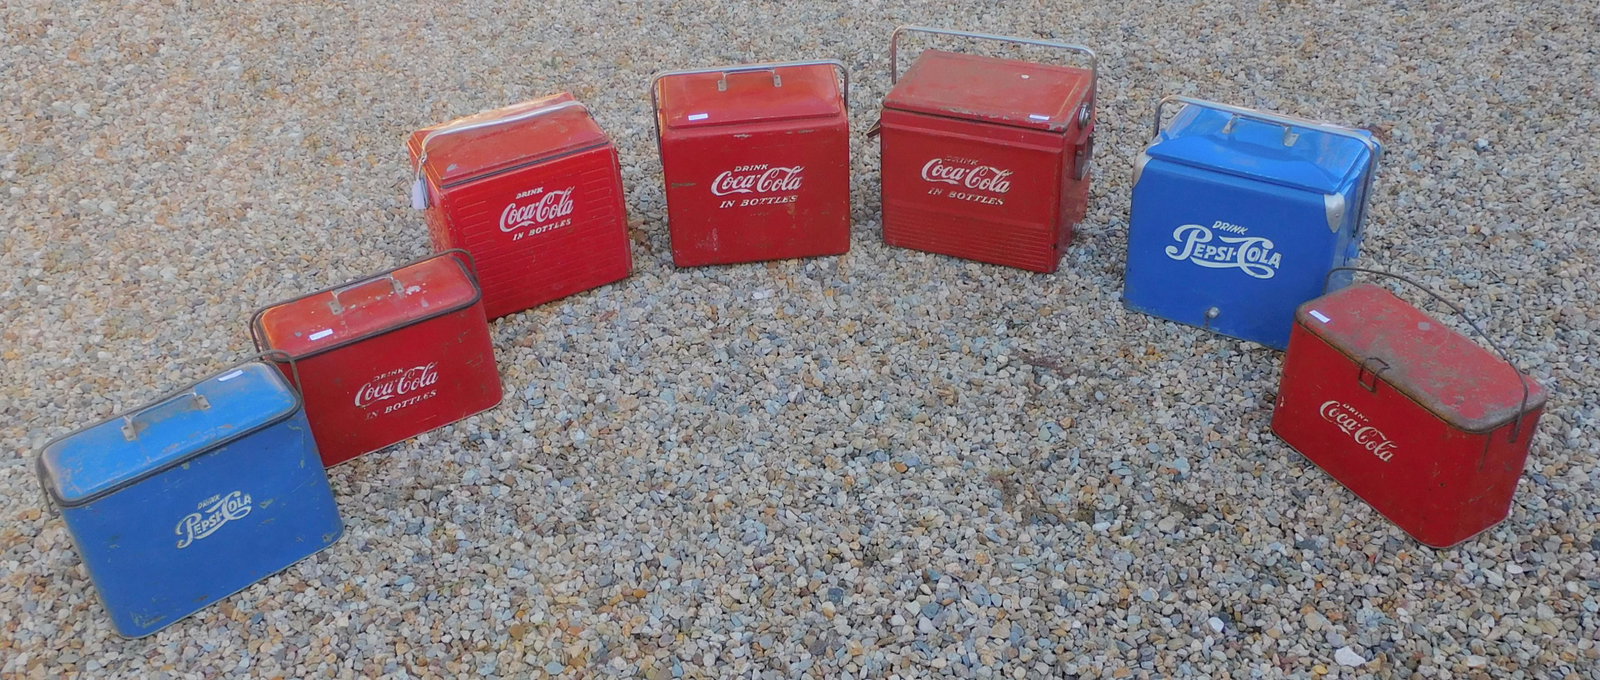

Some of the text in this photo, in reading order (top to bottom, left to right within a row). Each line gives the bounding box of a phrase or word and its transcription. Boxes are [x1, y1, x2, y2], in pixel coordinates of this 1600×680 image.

[734, 163, 769, 172] DRINK
[921, 158, 1013, 193] Coca-Cola
[710, 165, 805, 196] Coca-Cola
[515, 186, 544, 200] DRINK
[719, 195, 799, 208] IN BOTTLES
[927, 187, 1005, 205] IN BOTTLES
[499, 185, 576, 232] Coca-Cola
[512, 218, 572, 241] IN BOTTLES
[1212, 220, 1248, 235] DRINK
[354, 361, 438, 408] Coca-Cola
[384, 389, 437, 414] BOTTLES
[1320, 400, 1398, 462] Coca-Cola
[197, 494, 220, 510] DRINK
